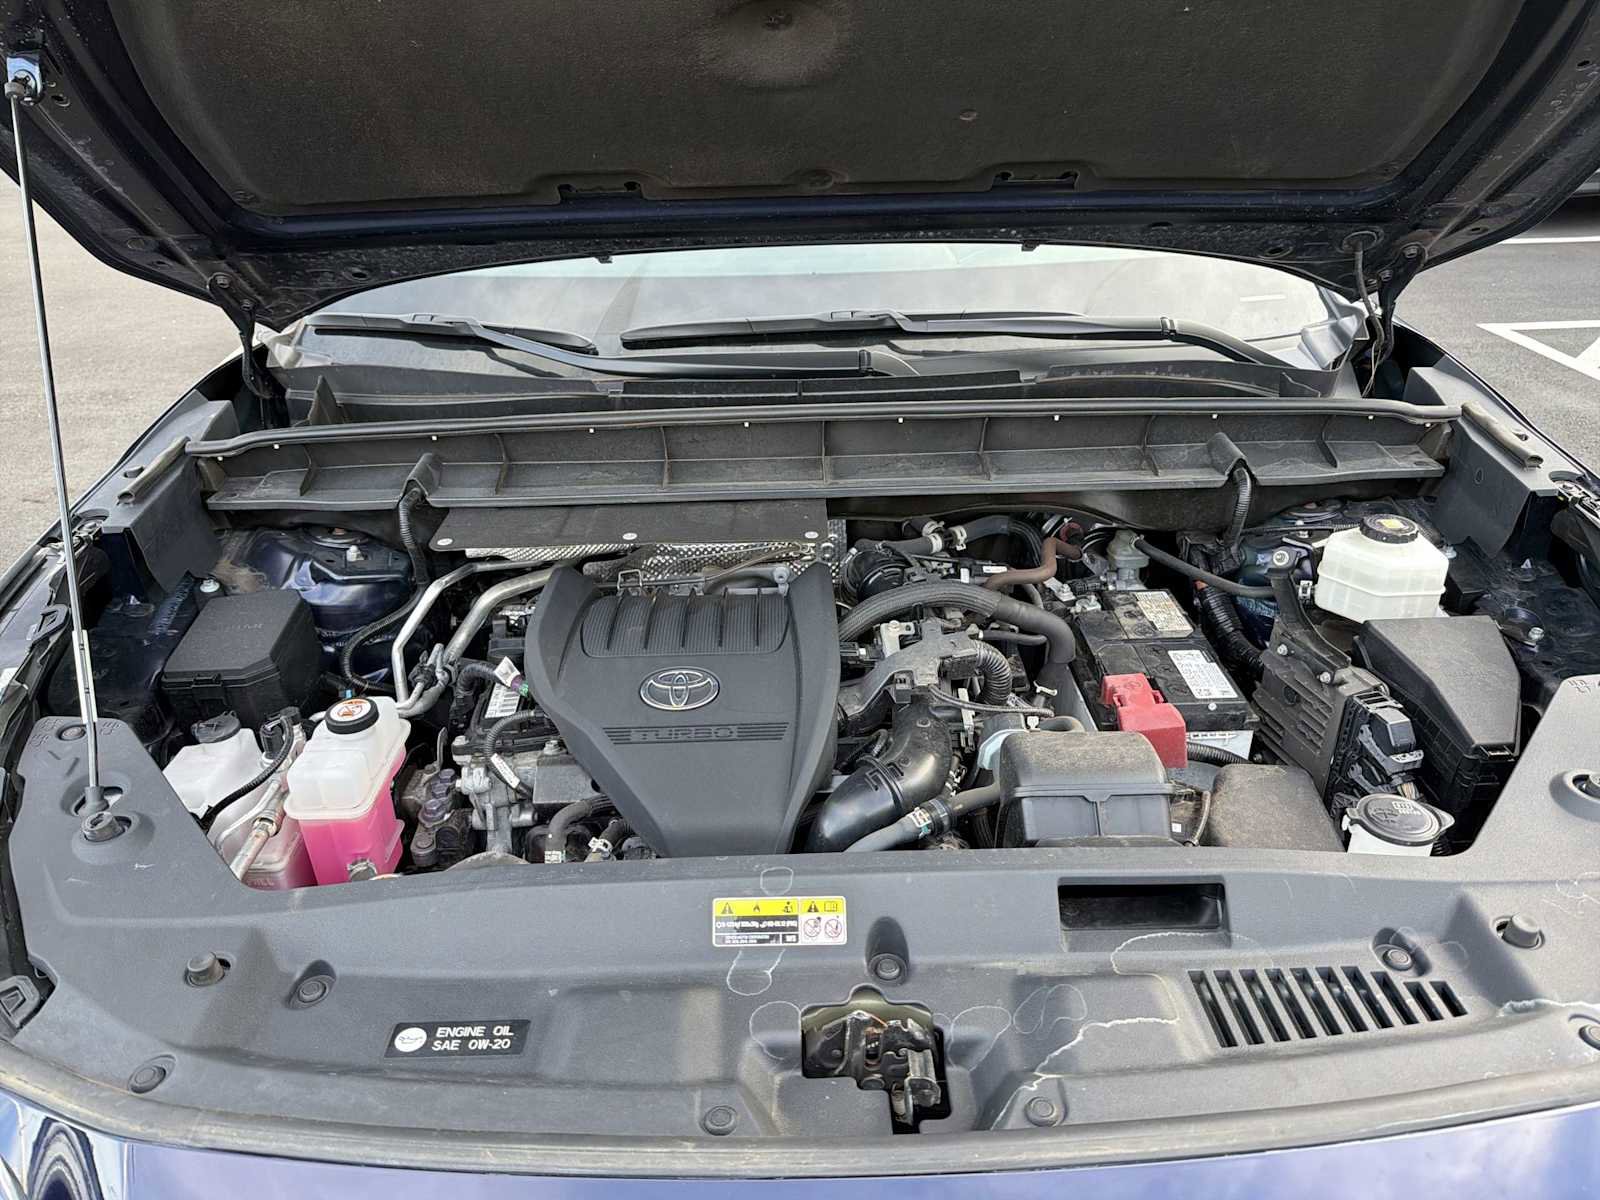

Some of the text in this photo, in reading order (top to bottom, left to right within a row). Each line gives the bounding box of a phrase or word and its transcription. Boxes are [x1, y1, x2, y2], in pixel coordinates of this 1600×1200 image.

[633, 727, 734, 741] TURBO
[436, 1025, 514, 1038] ENGINE OIL
[431, 1038, 511, 1051] SAE 0W-20
